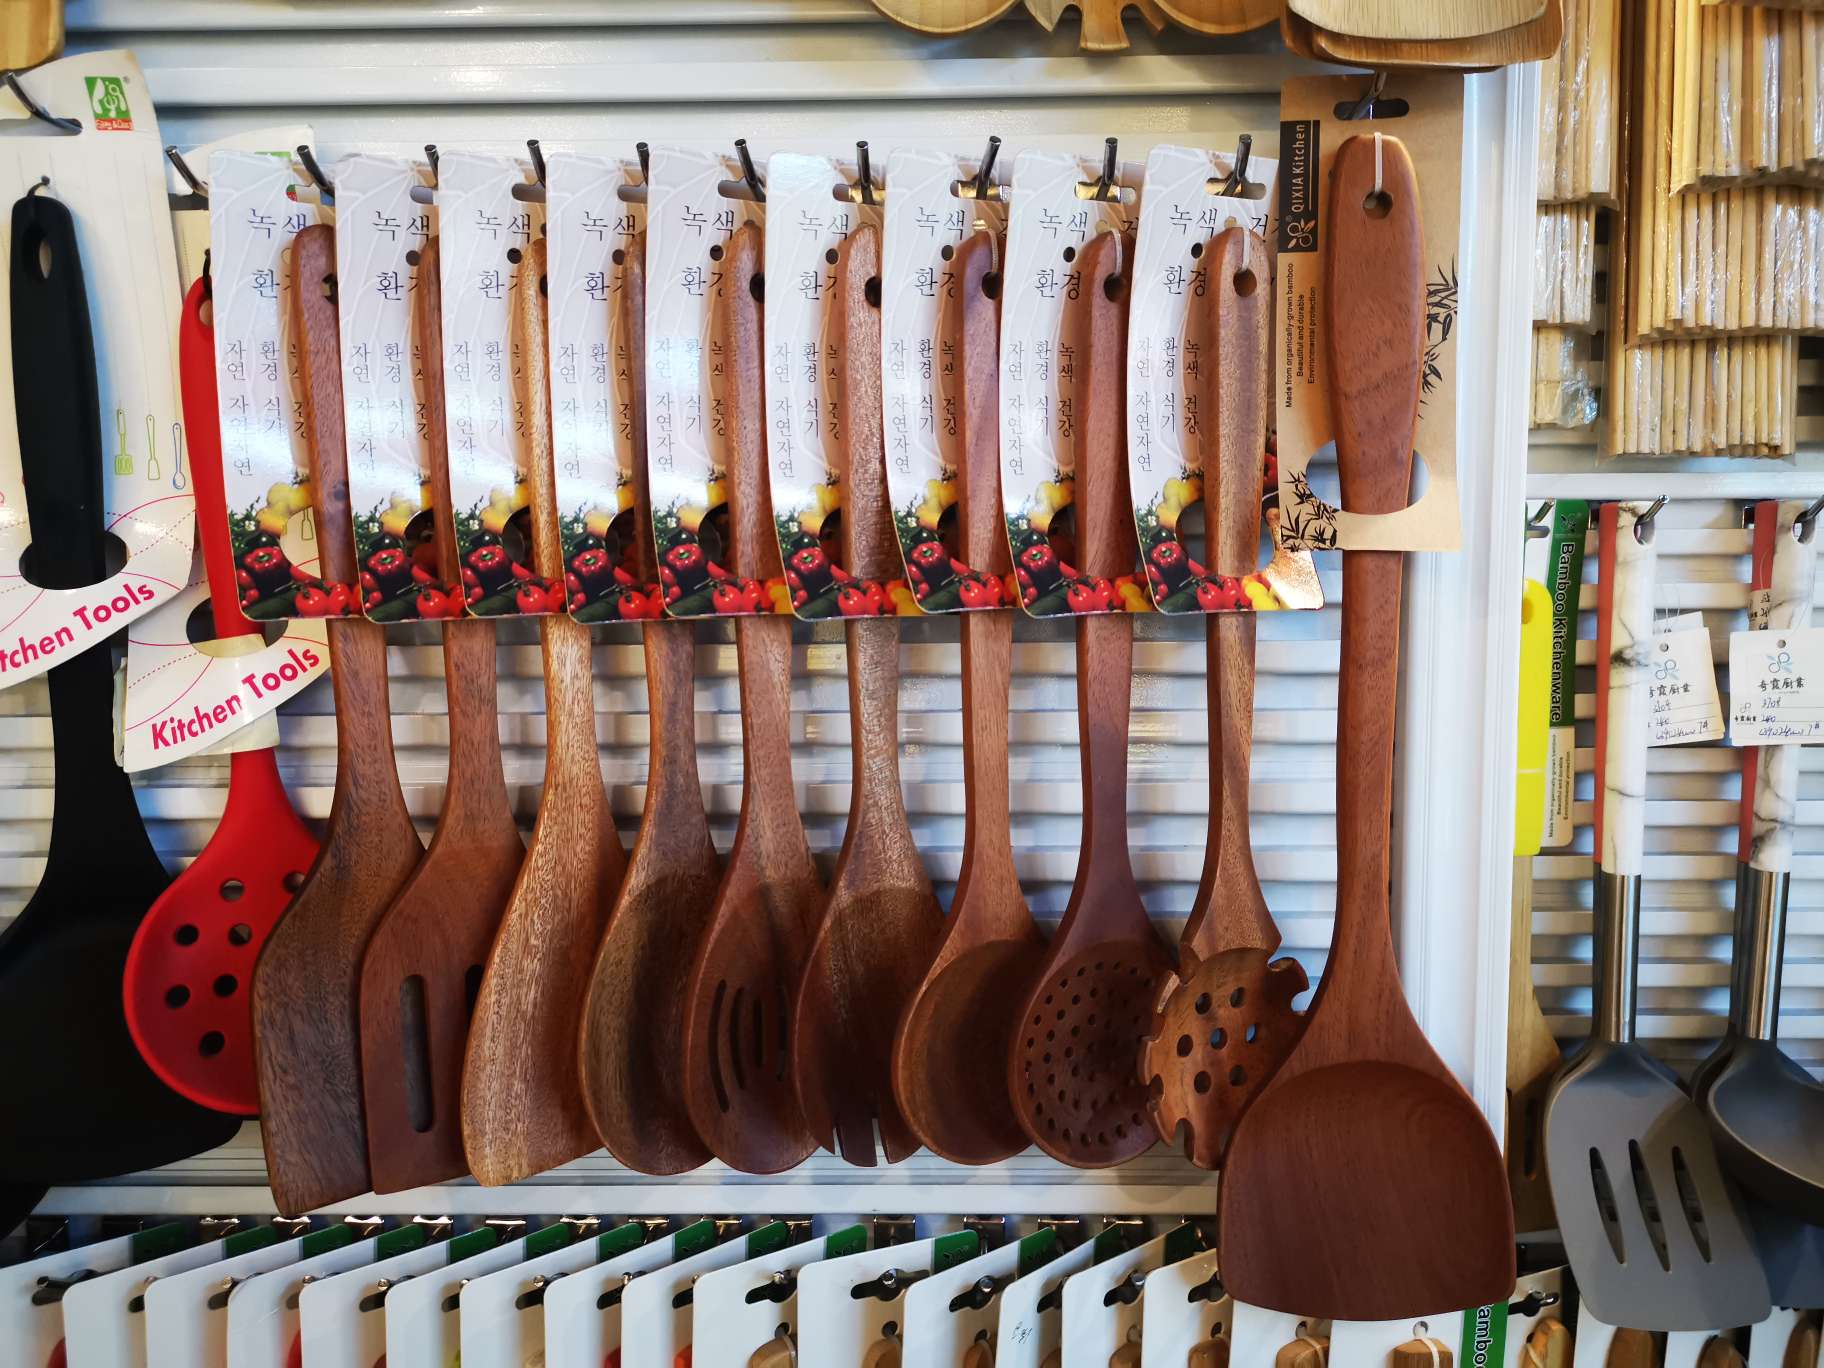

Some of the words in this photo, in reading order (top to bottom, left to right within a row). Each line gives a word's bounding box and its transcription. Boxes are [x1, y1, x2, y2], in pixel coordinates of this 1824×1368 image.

[1292, 124, 1305, 174] Kitchen
[1291, 177, 1305, 213] QIXIA
[372, 211, 430, 241] 녹색
[476, 210, 531, 243] 녹색
[582, 211, 636, 241] 녹색
[681, 205, 734, 240] 녹색
[797, 210, 849, 241] 녹색
[915, 207, 965, 240] 녹색
[1039, 208, 1088, 241] 녹색
[1170, 204, 1217, 240] 녹색
[1035, 268, 1081, 300] 환경
[1163, 265, 1207, 297] 환경
[1286, 263, 1294, 295] bamboo
[1297, 294, 1305, 324] durable
[1308, 287, 1317, 326] protection
[227, 340, 246, 381] 자연
[260, 341, 280, 382] 환경
[352, 343, 371, 383] 자연
[384, 343, 403, 383] 환경
[454, 341, 471, 382] 자연
[560, 343, 577, 384] 자연
[591, 343, 607, 383] 환경
[803, 343, 819, 383] 환경
[918, 339, 933, 379] 환경
[1035, 340, 1051, 380] 환경
[1059, 343, 1074, 383] 녹색
[1162, 337, 1177, 378] 환경
[1185, 340, 1200, 380] 녹색
[1285, 367, 1293, 385] from
[920, 394, 933, 434] 식기
[1161, 393, 1175, 433] 식기
[1184, 395, 1199, 434] 건강
[1285, 387, 1293, 408] Made
[804, 398, 819, 438] 식기
[1058, 398, 1074, 438] 건강
[1553, 542, 1575, 614] Bamboo
[73, 583, 155, 631] Tools
[1549, 617, 1567, 722] Kitchenware
[151, 693, 242, 750] Kitchen
[241, 647, 320, 700] Tools
